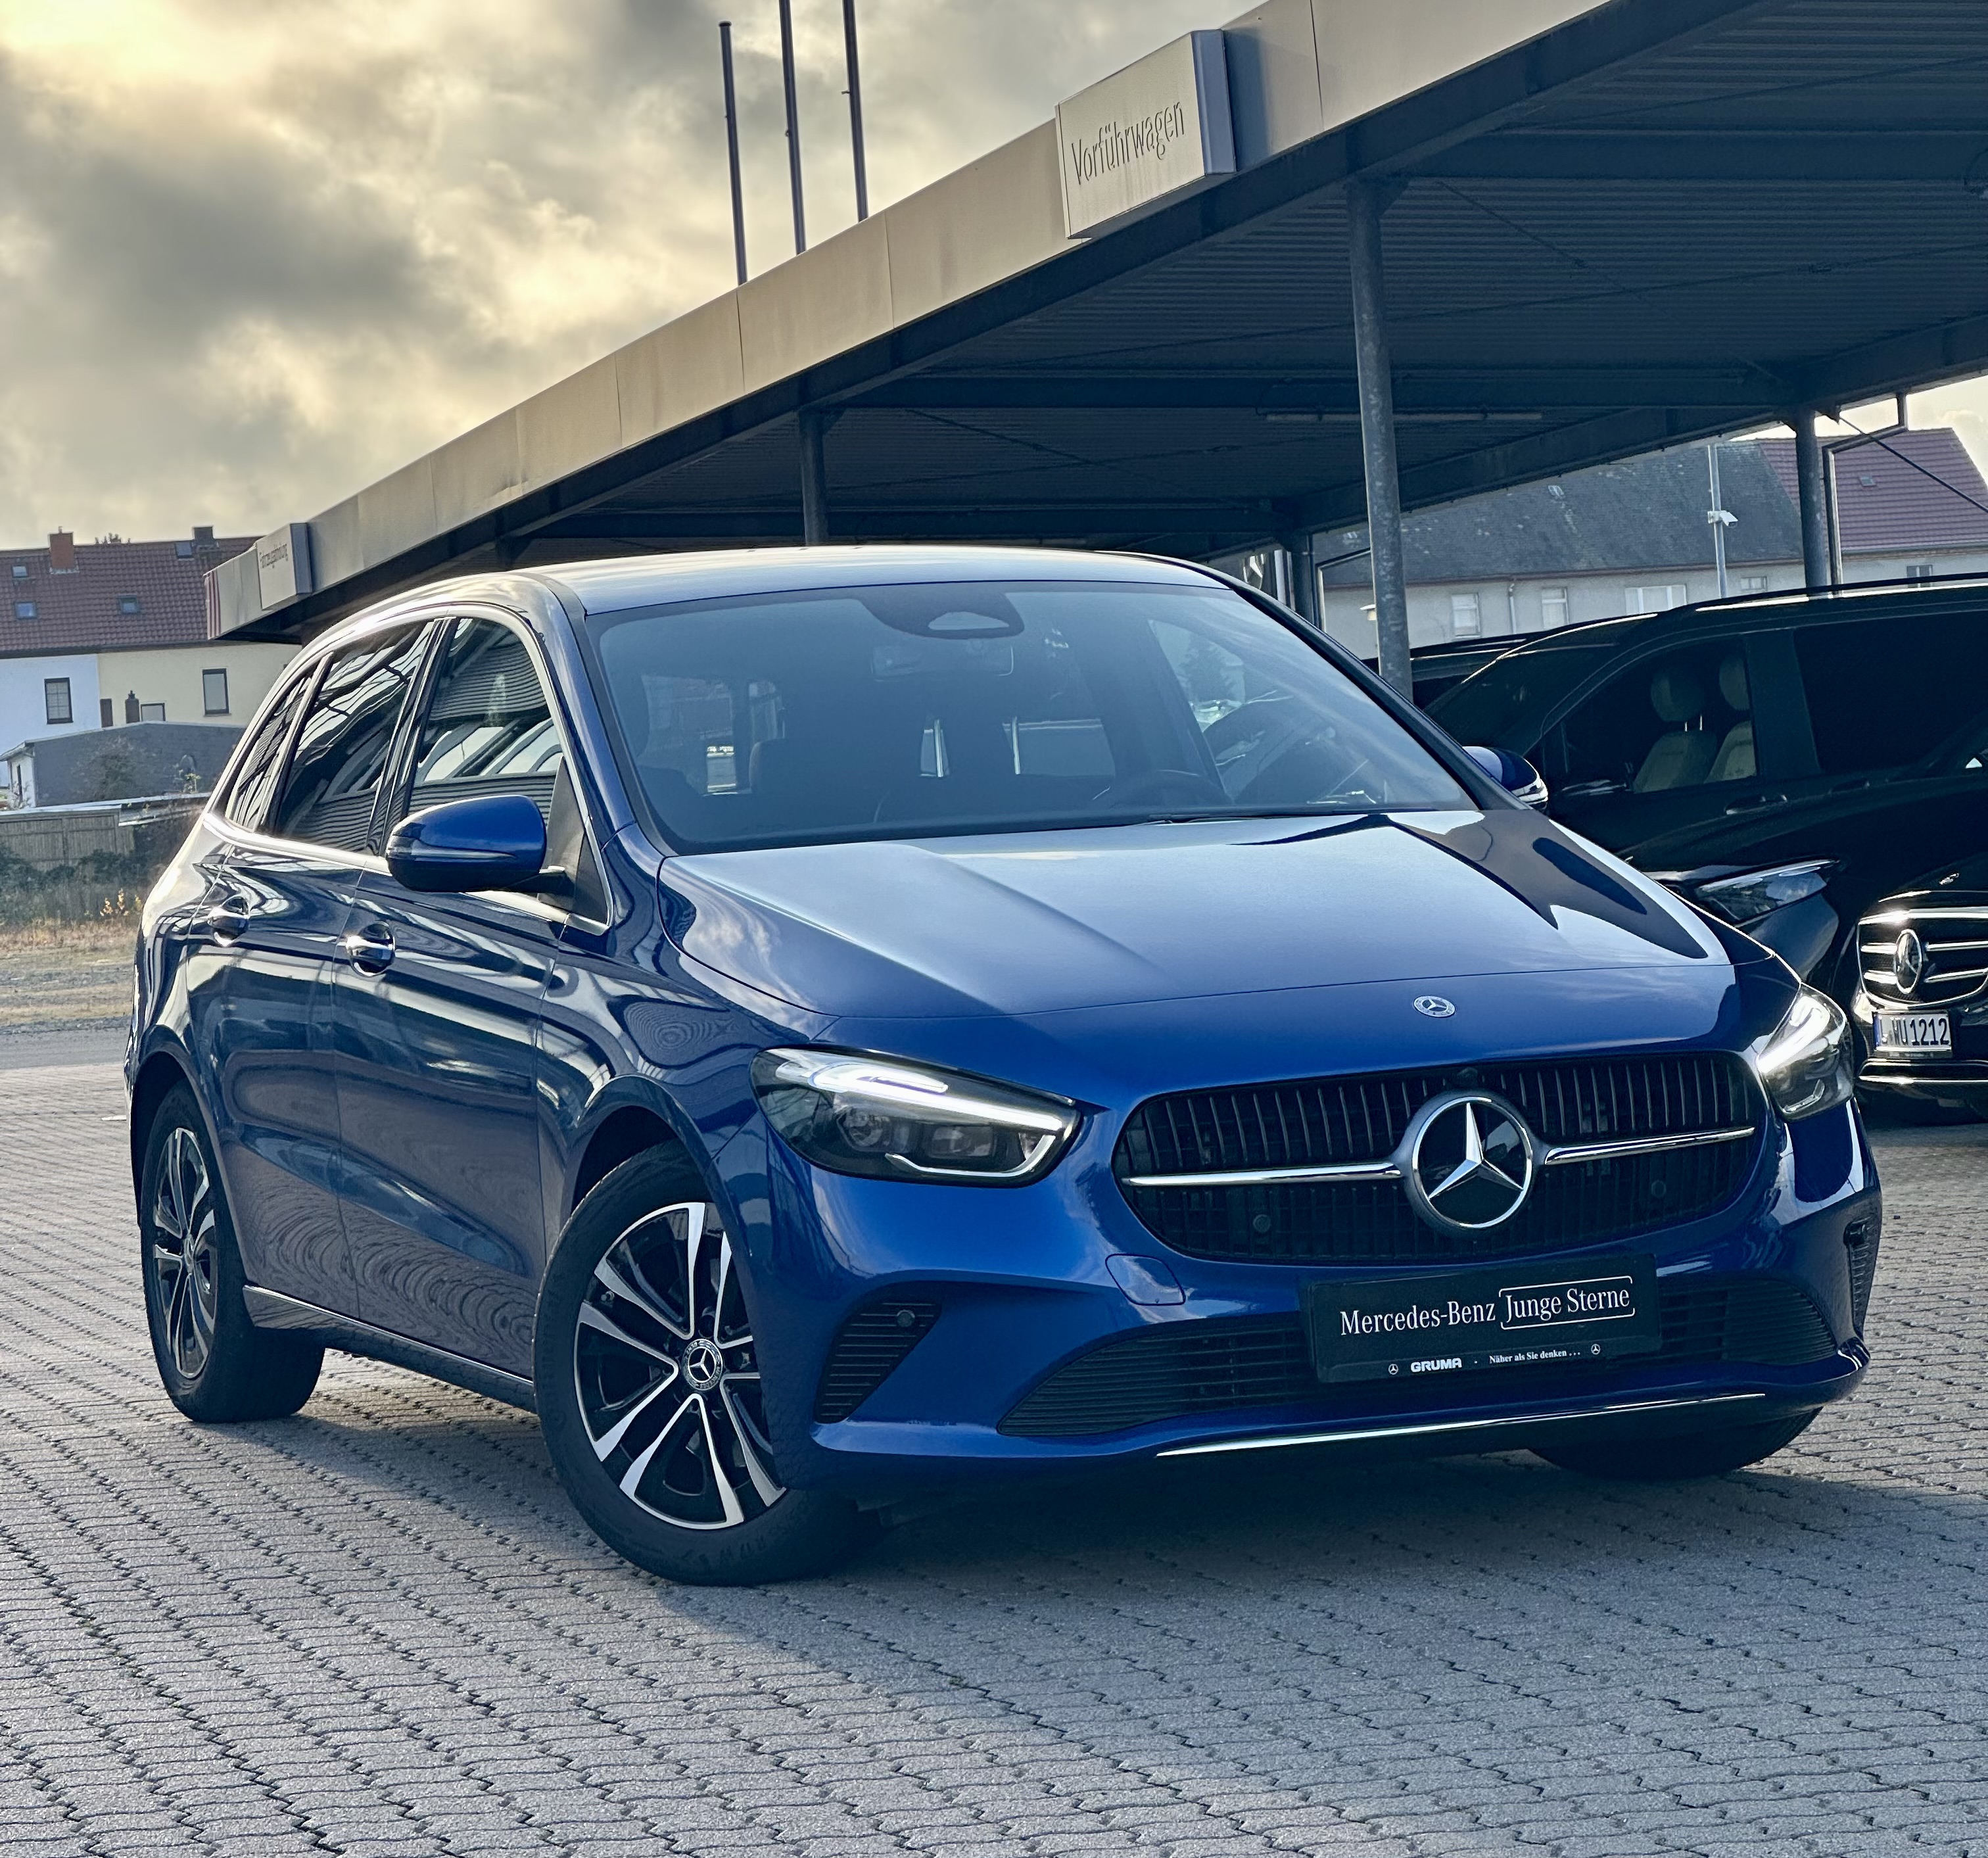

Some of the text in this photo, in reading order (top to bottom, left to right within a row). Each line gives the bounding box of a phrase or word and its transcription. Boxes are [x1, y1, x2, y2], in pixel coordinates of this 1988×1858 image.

[1071, 101, 1184, 186] Vorführwagen
[1340, 1288, 1630, 1336] Mercedes-Benz Junge Sterne
[1410, 1357, 1463, 1373] GRUMA
[1489, 1354, 1513, 1364] Näher
[1514, 1352, 1526, 1362] als
[1526, 1351, 1540, 1360] Sie
[1540, 1349, 1567, 1359] denken
